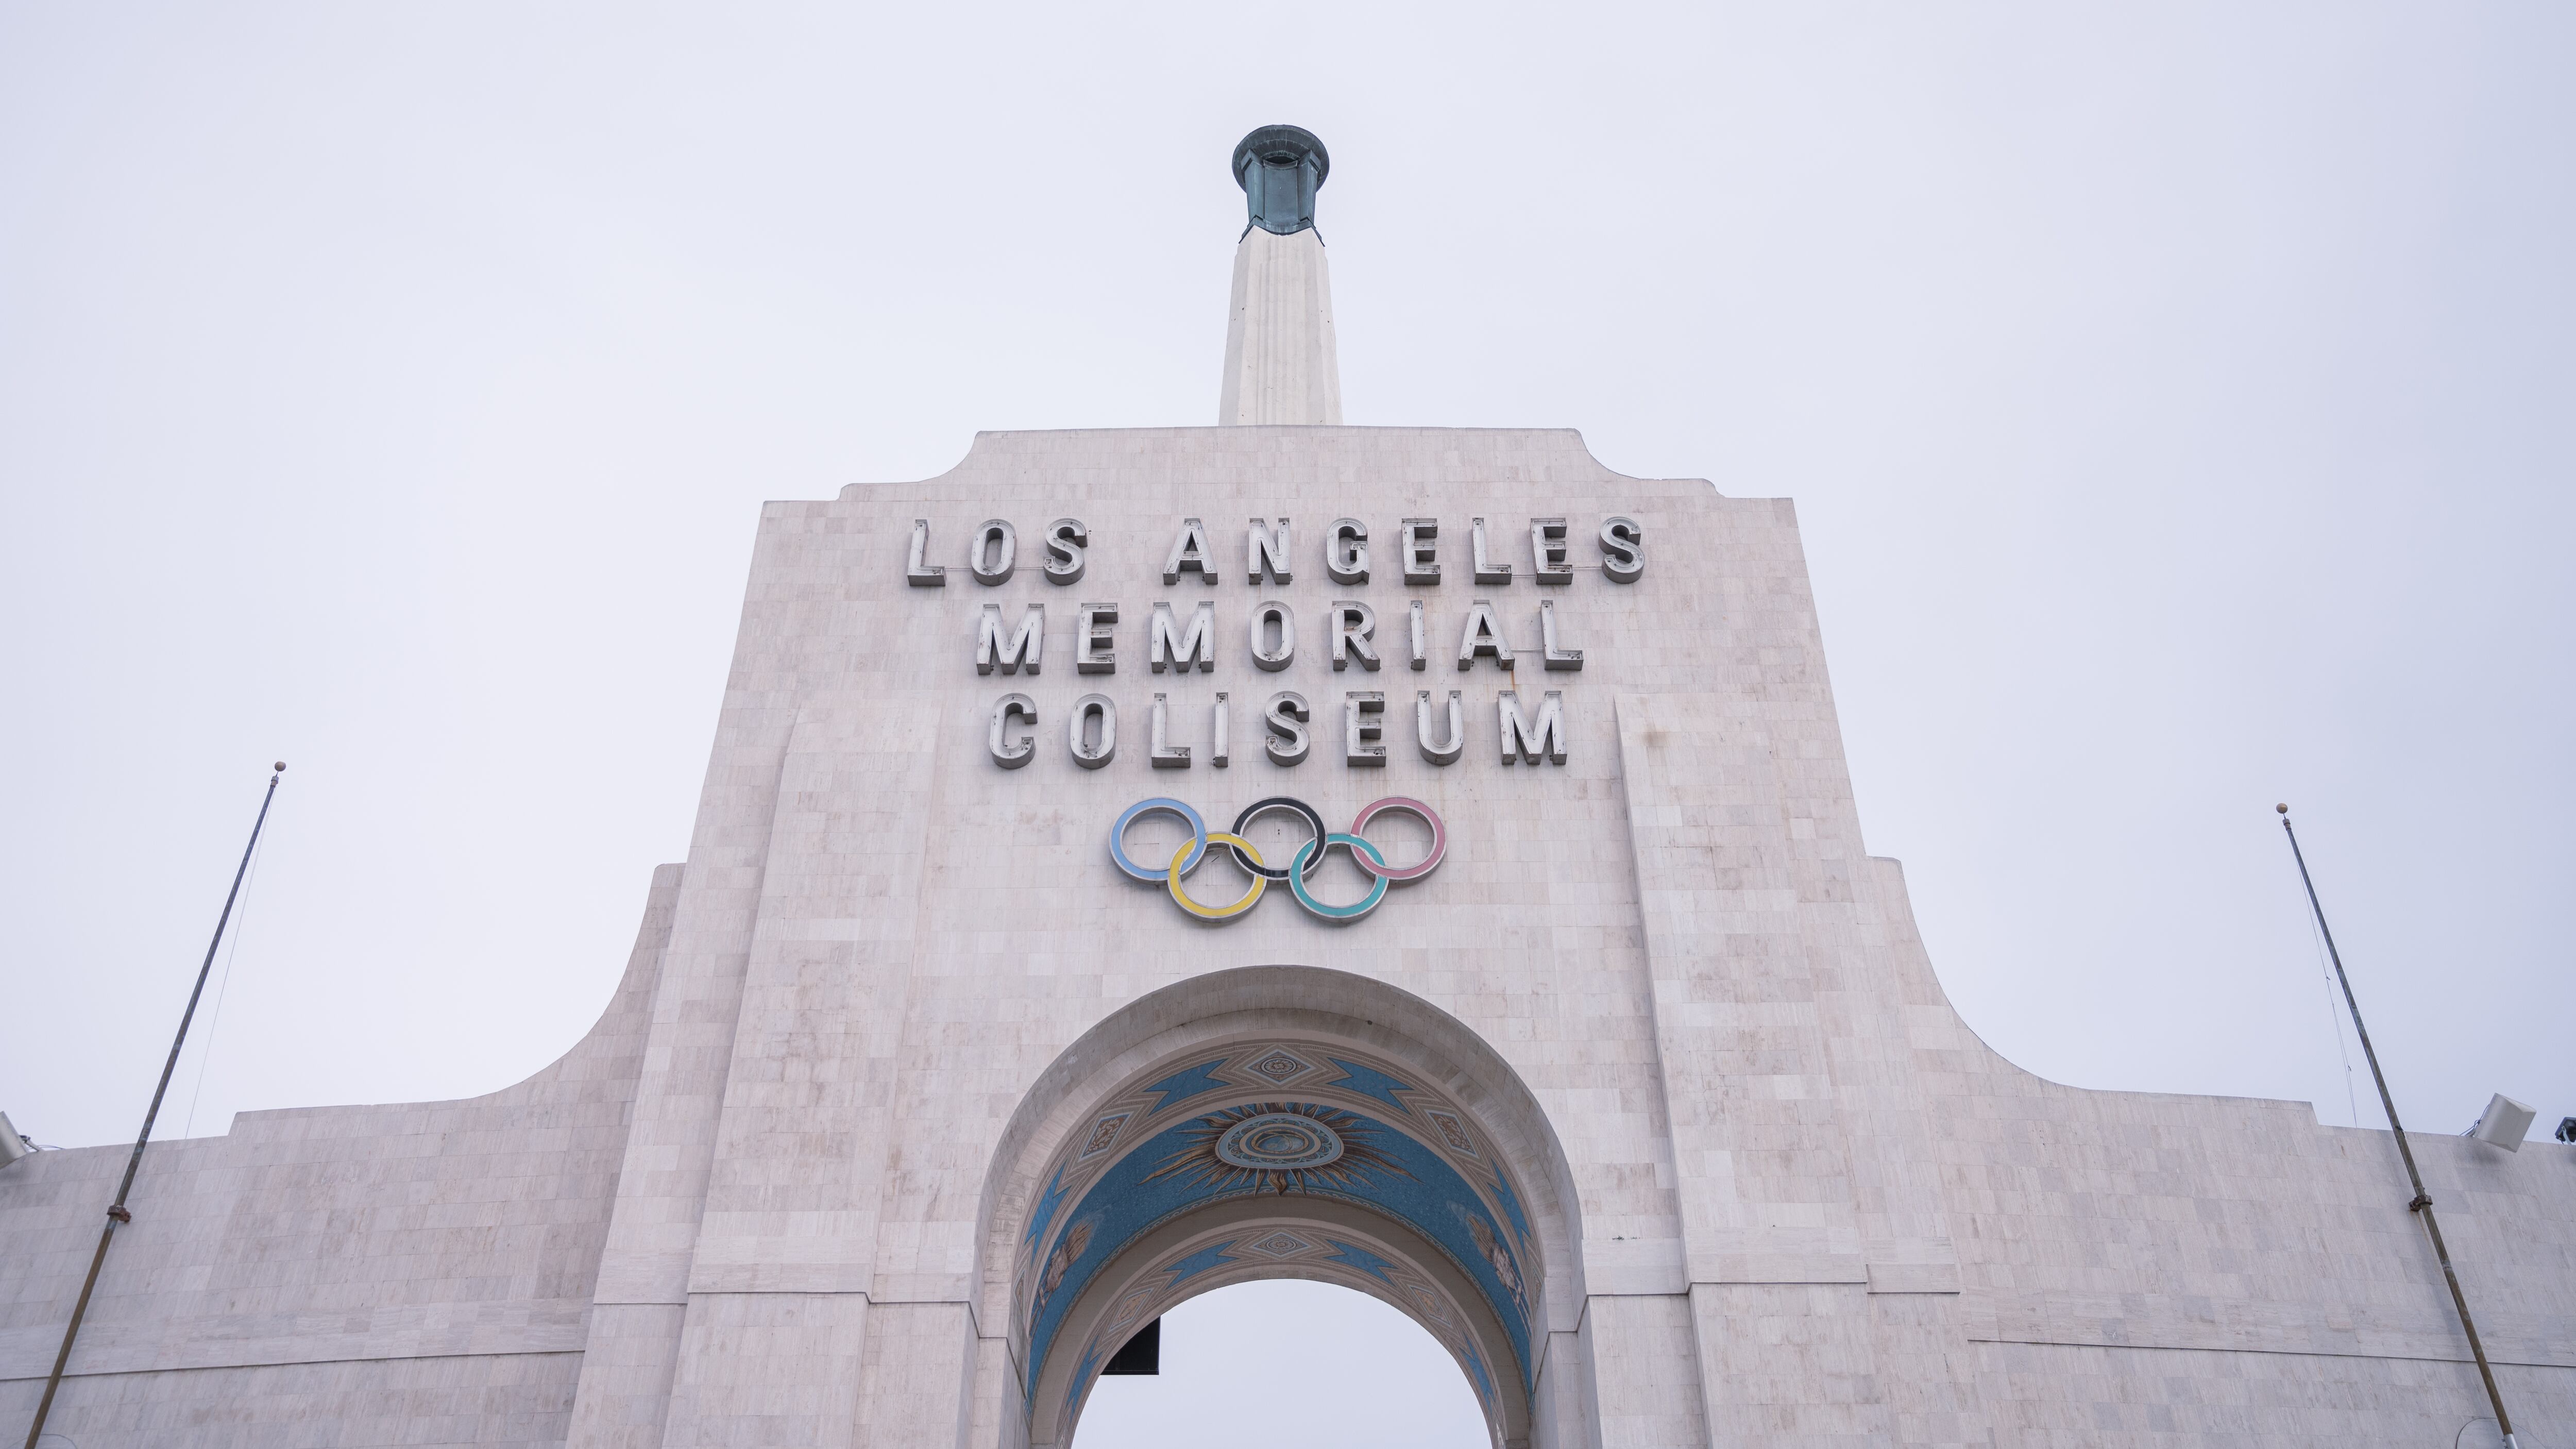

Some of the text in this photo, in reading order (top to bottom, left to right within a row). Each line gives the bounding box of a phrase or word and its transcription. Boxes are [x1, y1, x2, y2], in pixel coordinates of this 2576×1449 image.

[907, 516, 1645, 586] LOS ANGELES
[976, 600, 1584, 675] MEMORIAL
[989, 690, 1567, 769] COLISEUM
